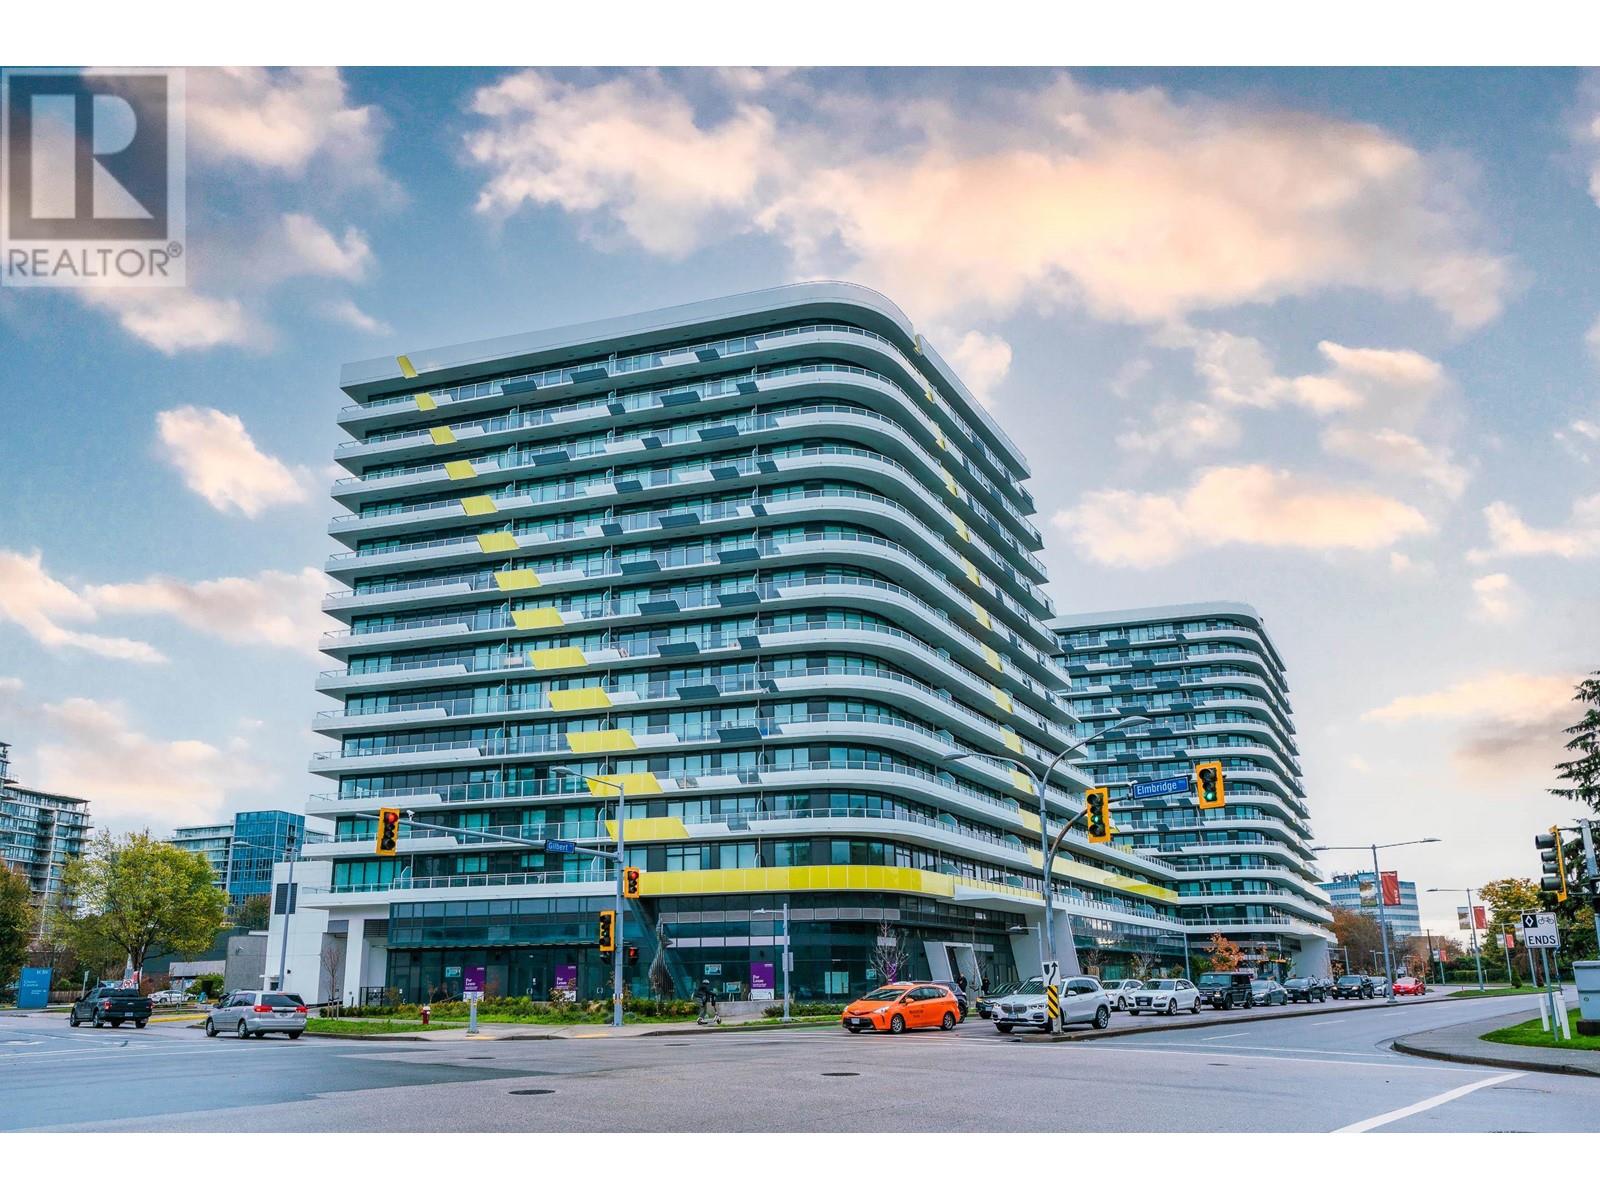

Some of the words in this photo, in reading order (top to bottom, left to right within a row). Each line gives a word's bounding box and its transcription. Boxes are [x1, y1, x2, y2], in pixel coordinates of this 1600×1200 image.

[1136, 780, 1177, 795] Elmbridge
[548, 841, 568, 851] Gilbert
[1528, 935, 1556, 945] ENDS
